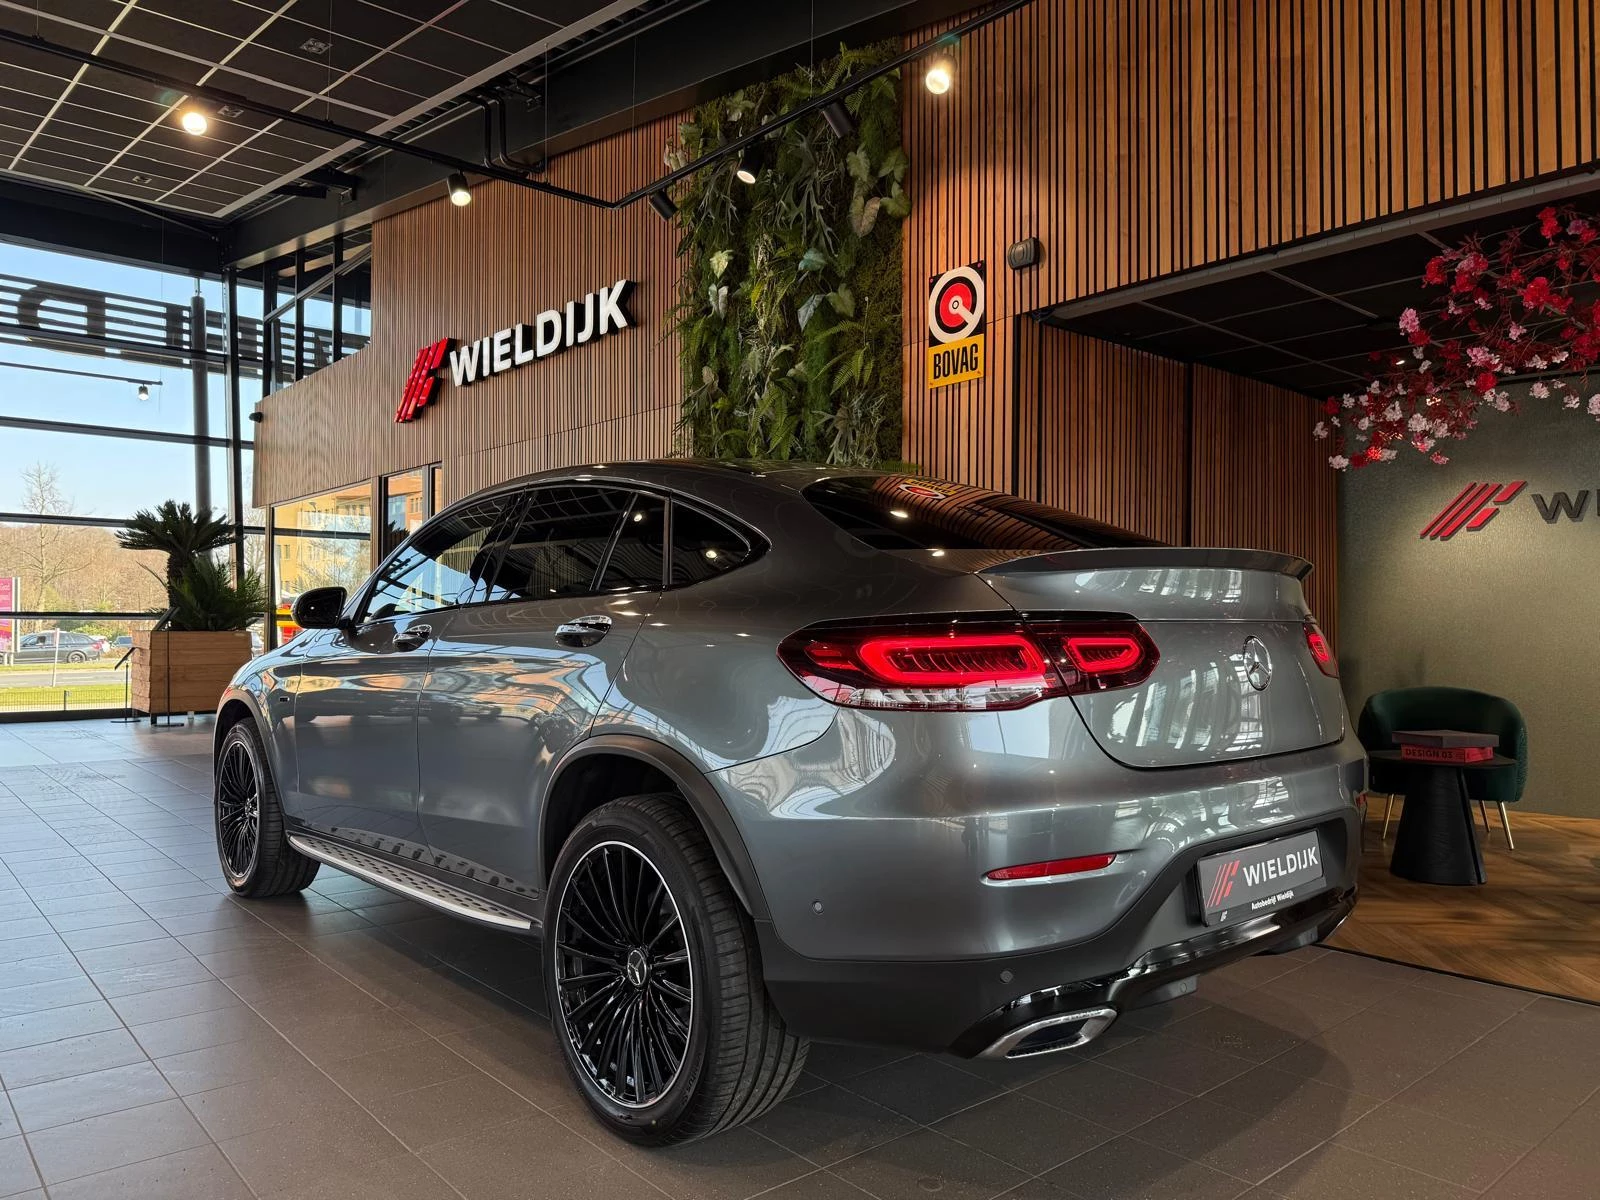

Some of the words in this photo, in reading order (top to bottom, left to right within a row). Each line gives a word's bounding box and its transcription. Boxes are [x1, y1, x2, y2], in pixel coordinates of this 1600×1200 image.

[450, 279, 628, 387] WIELDIJK
[933, 343, 979, 379] BOVAG
[1405, 748, 1440, 758] DESIGN
[1243, 846, 1318, 887] WIELDIJK
[1251, 895, 1276, 910] Autobedrijf
[1277, 889, 1295, 901] Wieldijk
